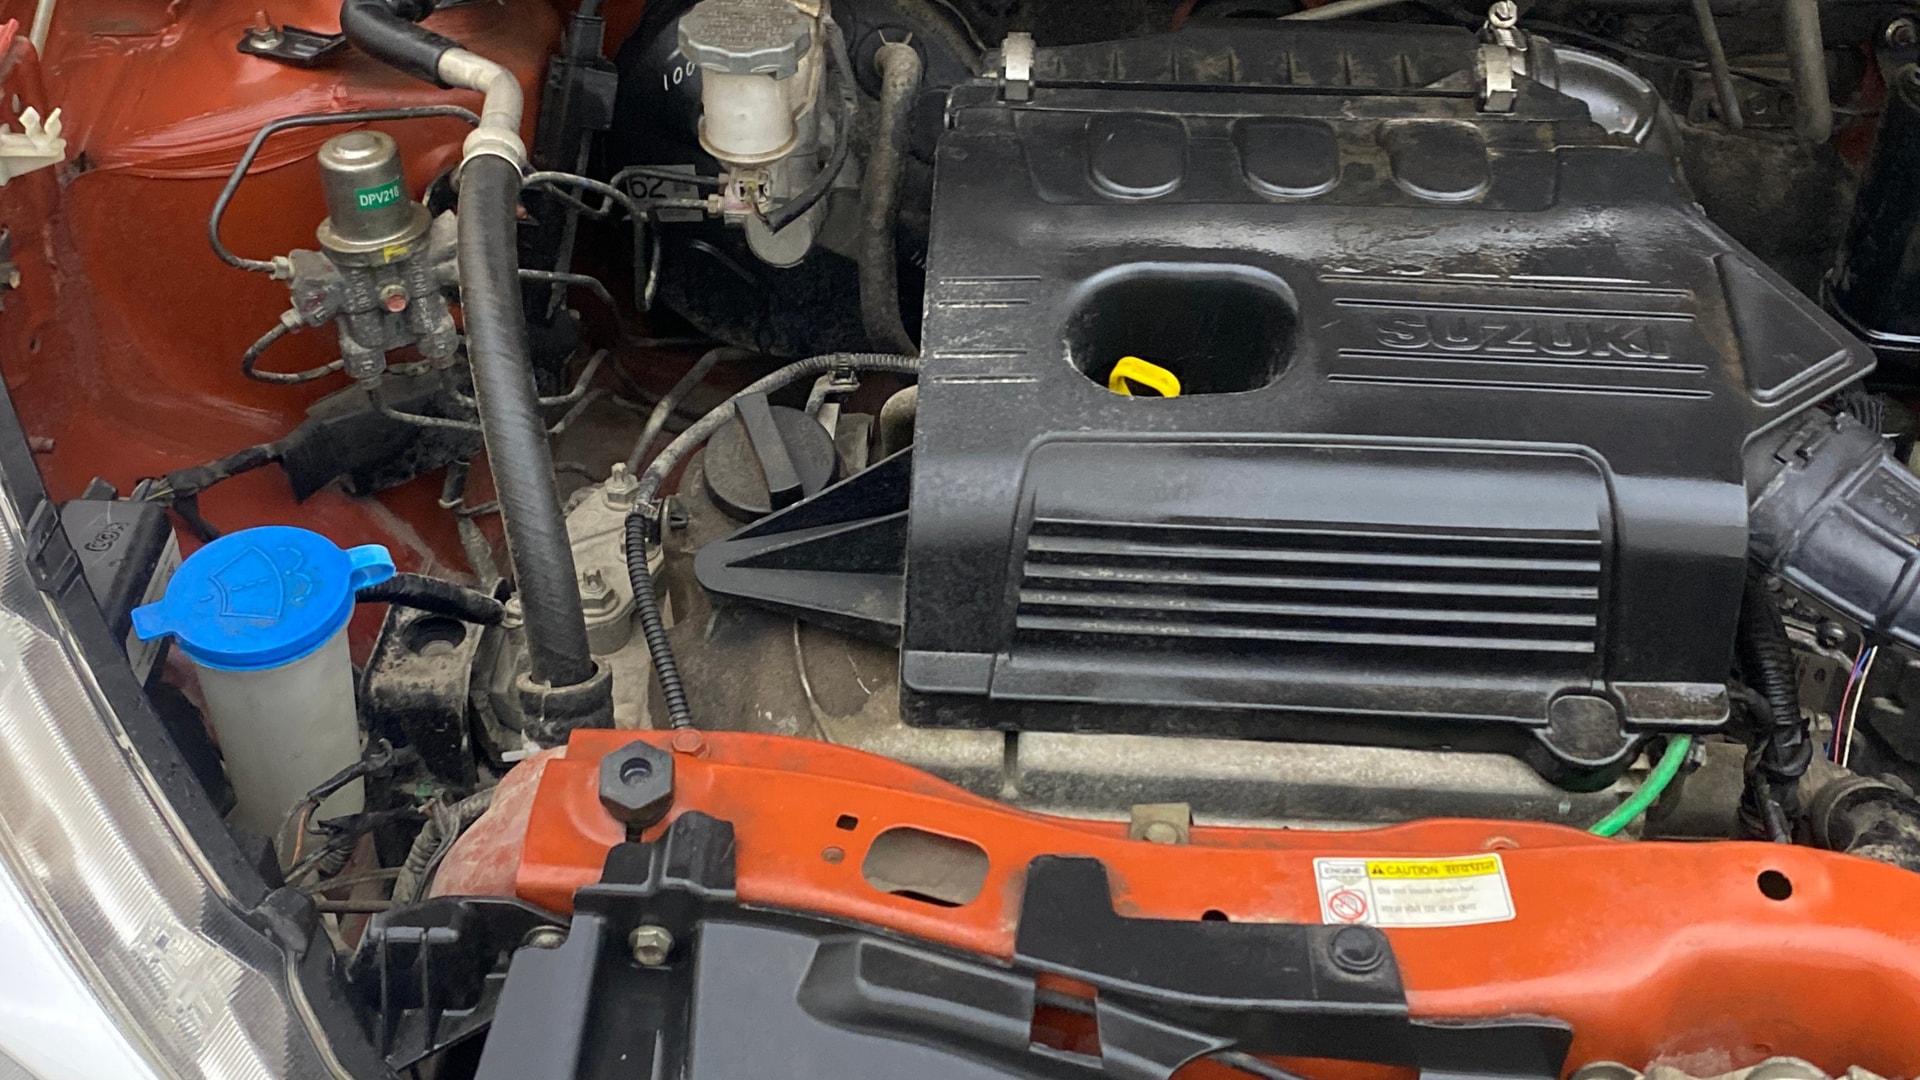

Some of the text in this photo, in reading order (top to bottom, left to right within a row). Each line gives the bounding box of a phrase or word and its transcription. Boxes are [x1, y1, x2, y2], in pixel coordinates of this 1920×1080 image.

[1376, 311, 1669, 360] SUZUKI
[1324, 867, 1361, 875] ENGINE
[1386, 865, 1439, 876] CAUTION
